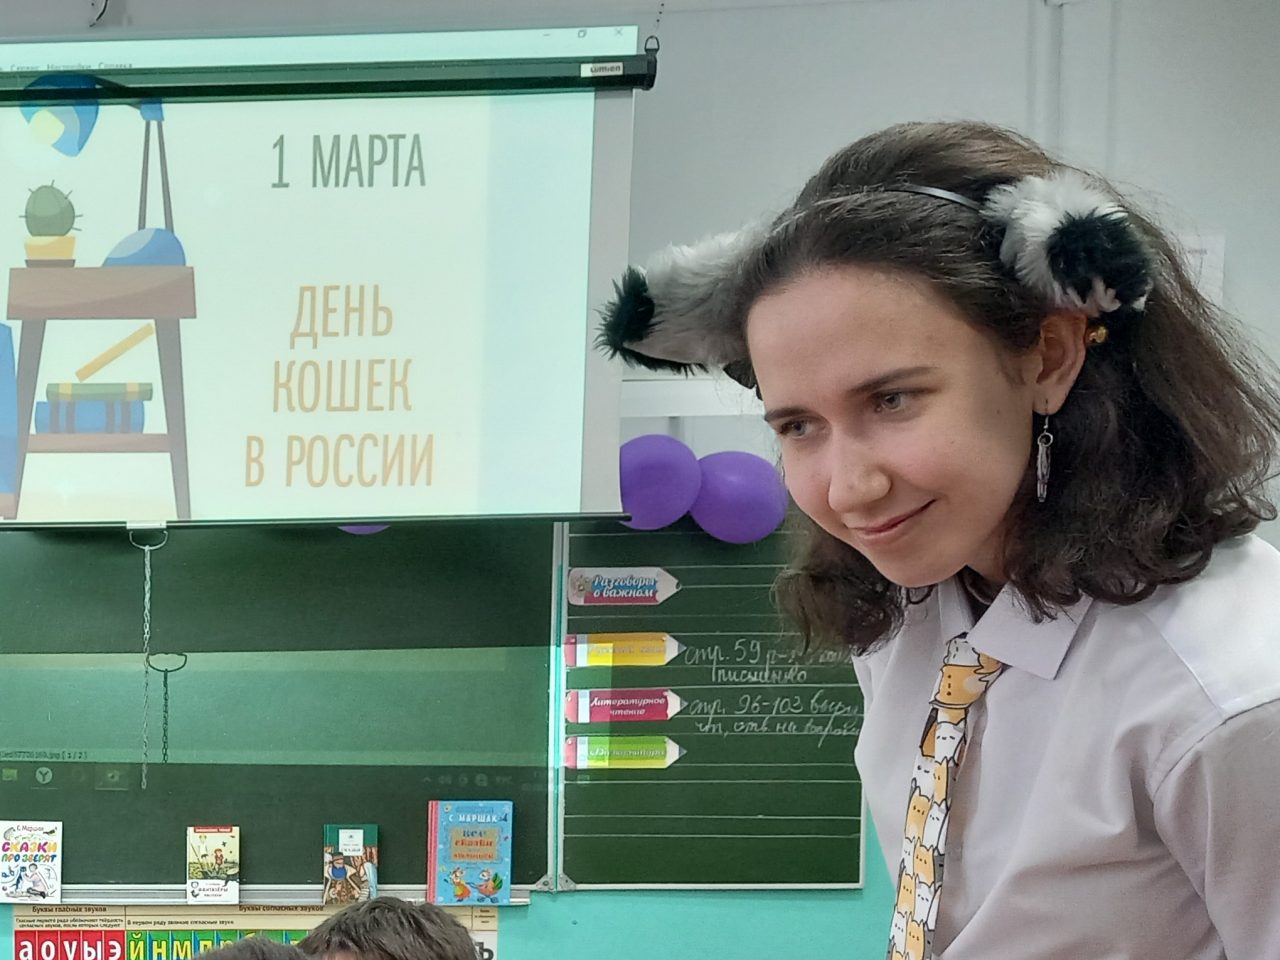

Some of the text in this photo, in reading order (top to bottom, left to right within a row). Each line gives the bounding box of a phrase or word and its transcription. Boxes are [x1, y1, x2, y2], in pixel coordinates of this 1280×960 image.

[270, 133, 427, 189] 1 МАРТА
[289, 284, 393, 350] ДЕНЬ
[272, 358, 413, 413] КОШЕК
[244, 433, 435, 488] В РОССИИ
[593, 574, 657, 590] Разговоры
[593, 587, 654, 598] о важном
[734, 639, 761, 664] 59
[590, 696, 666, 707] Литературное
[734, 694, 803, 716] 96-103
[609, 708, 646, 716] чтение
[458, 812, 498, 823] МАРШАК
[2, 841, 58, 853] СКАЗКИ
[2, 853, 57, 863] ПРО ЗВЕРЯТ
[32, 905, 107, 914] Буквы гласных звуков
[238, 905, 261, 913] Буквы
[299, 905, 325, 913] звуков
